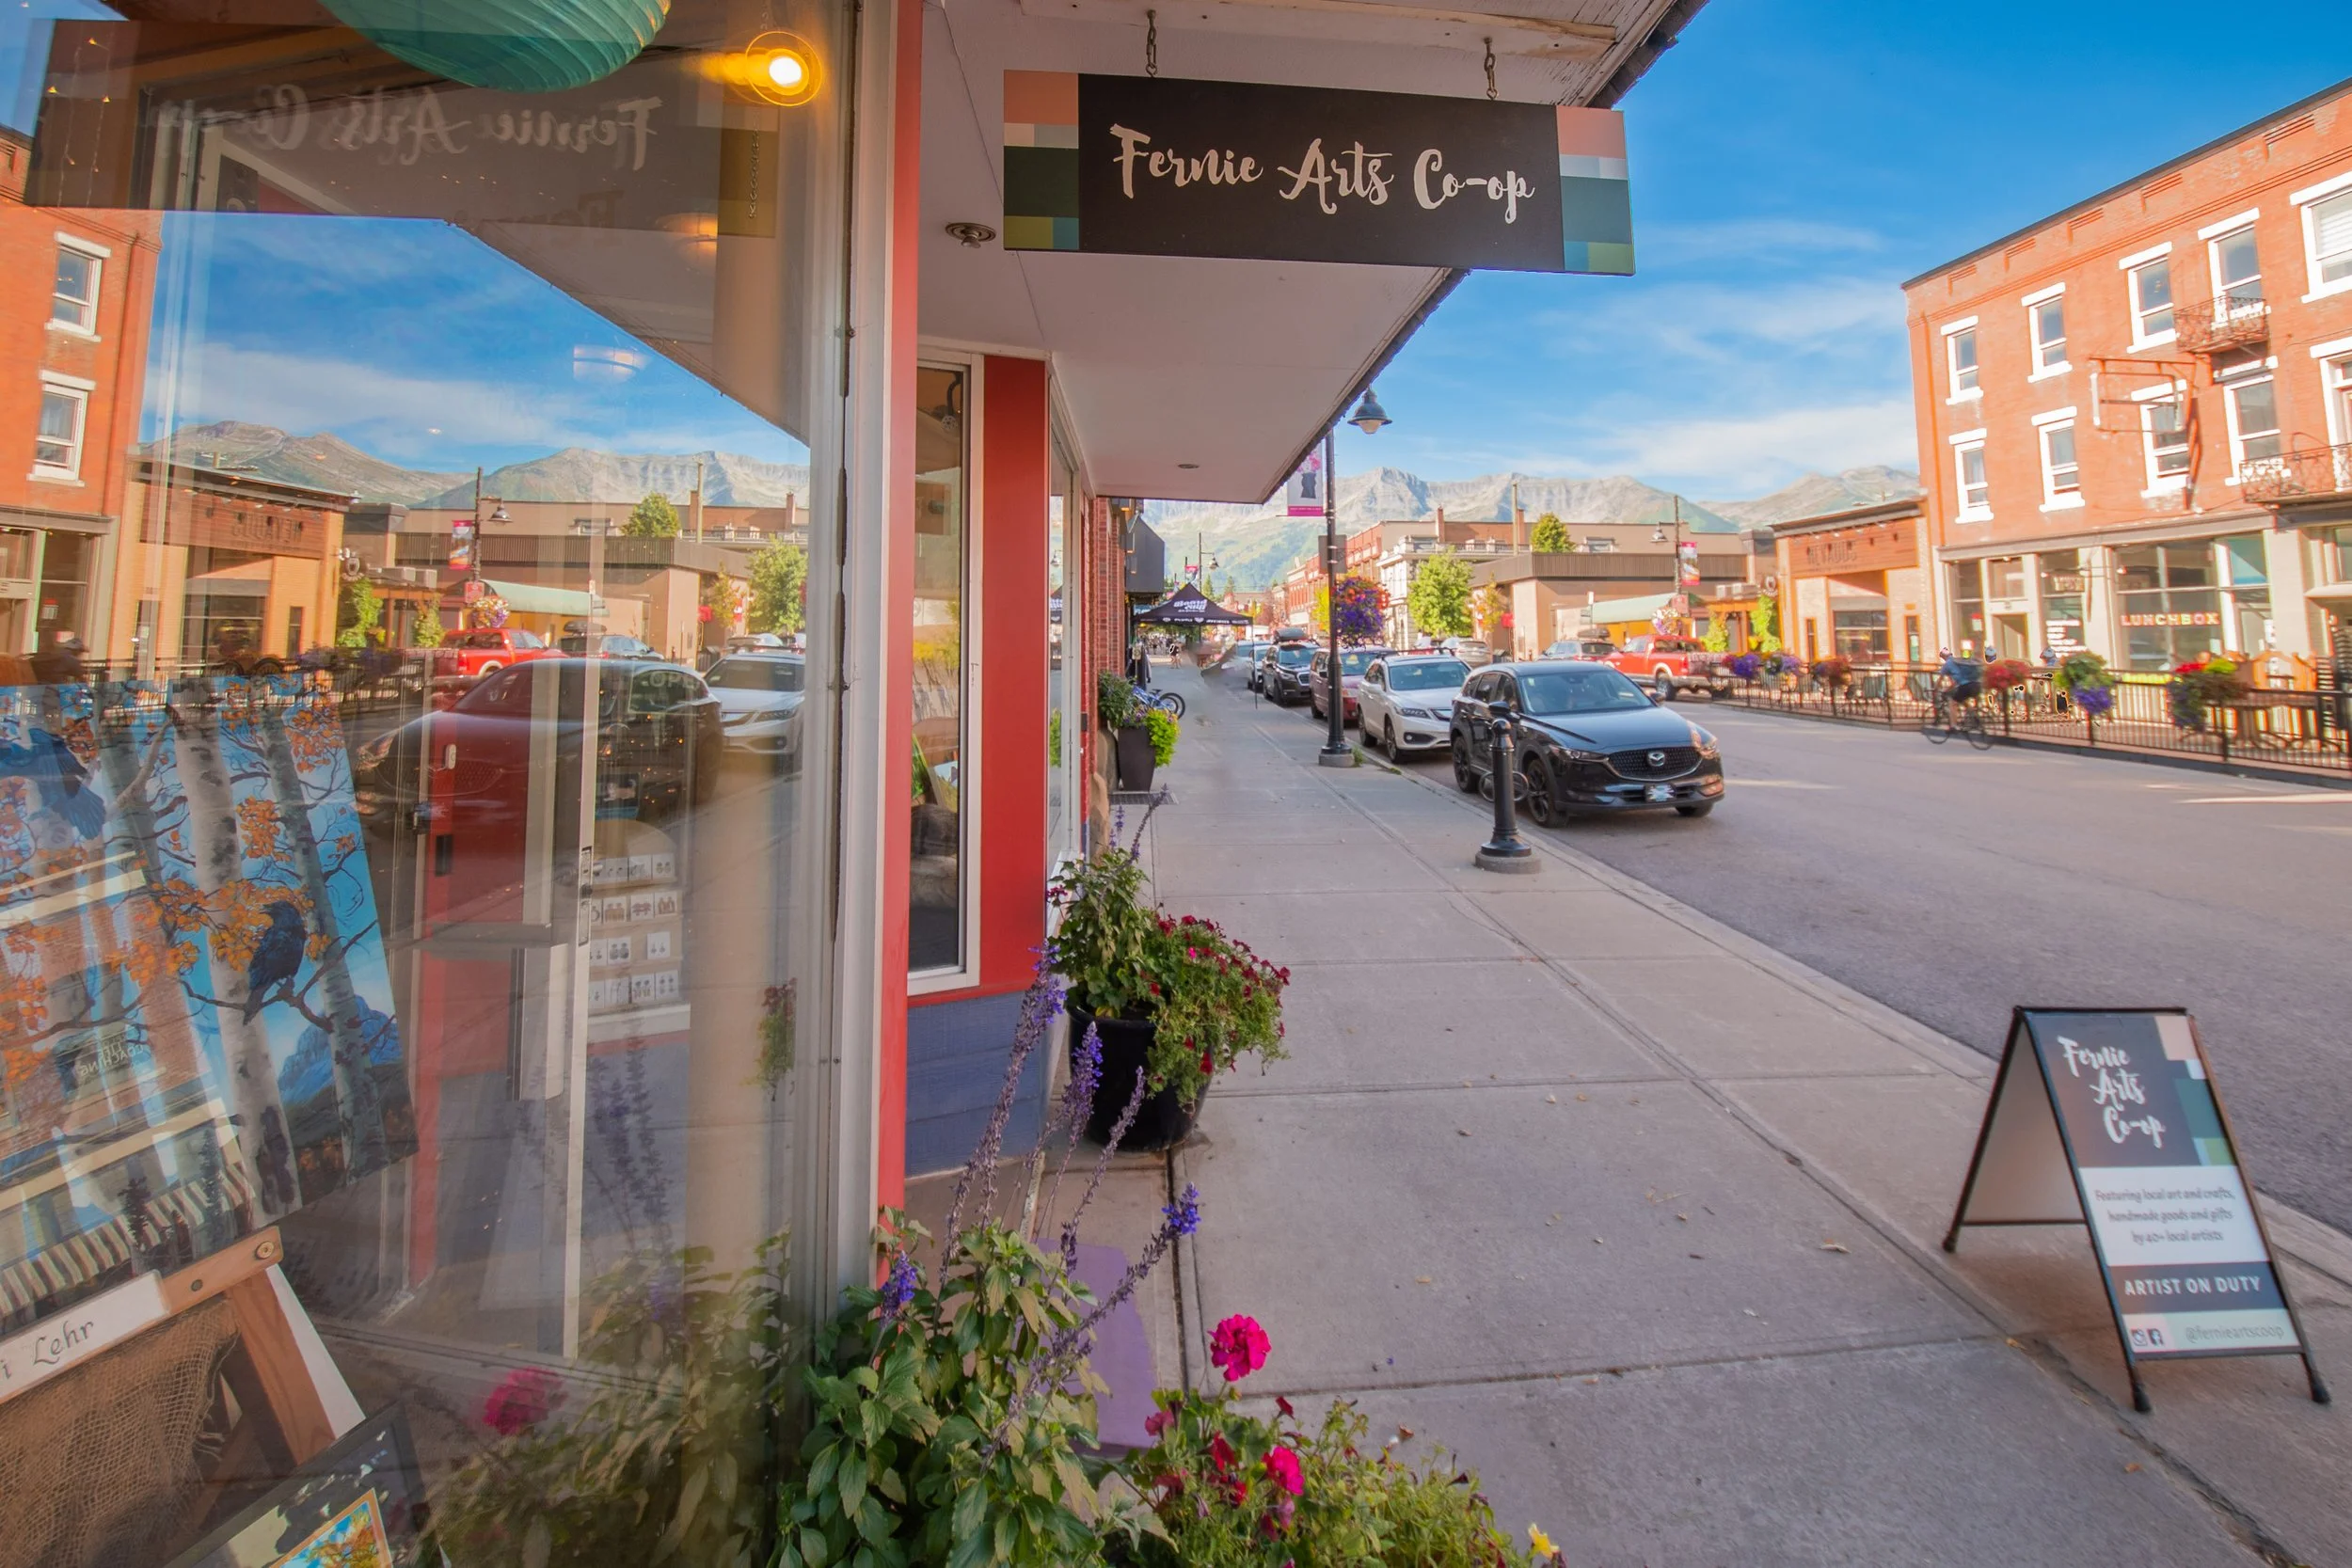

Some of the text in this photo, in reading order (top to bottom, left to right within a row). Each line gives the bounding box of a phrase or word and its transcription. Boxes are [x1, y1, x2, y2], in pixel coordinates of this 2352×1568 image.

[1109, 123, 1535, 225] Fernie Arts Co-op
[2121, 611, 2221, 626] LUNCHBOX
[2057, 1035, 2131, 1078] Fernie
[2089, 1067, 2146, 1112] Arts
[2103, 1105, 2167, 1149] Co-op
[2094, 1189, 2142, 1203] Featuring
[2142, 1188, 2164, 1200] local
[2167, 1189, 2183, 1199] art
[2184, 1187, 2202, 1199] and
[2107, 1206, 2234, 1224] handmade goods and gifts
[2131, 1230, 2144, 1246] by
[2165, 1228, 2189, 1243] local
[2191, 1228, 2224, 1242] artists
[2123, 1275, 2261, 1296] ARTIST ON DUTY
[32, 1320, 94, 1367] Lehr
